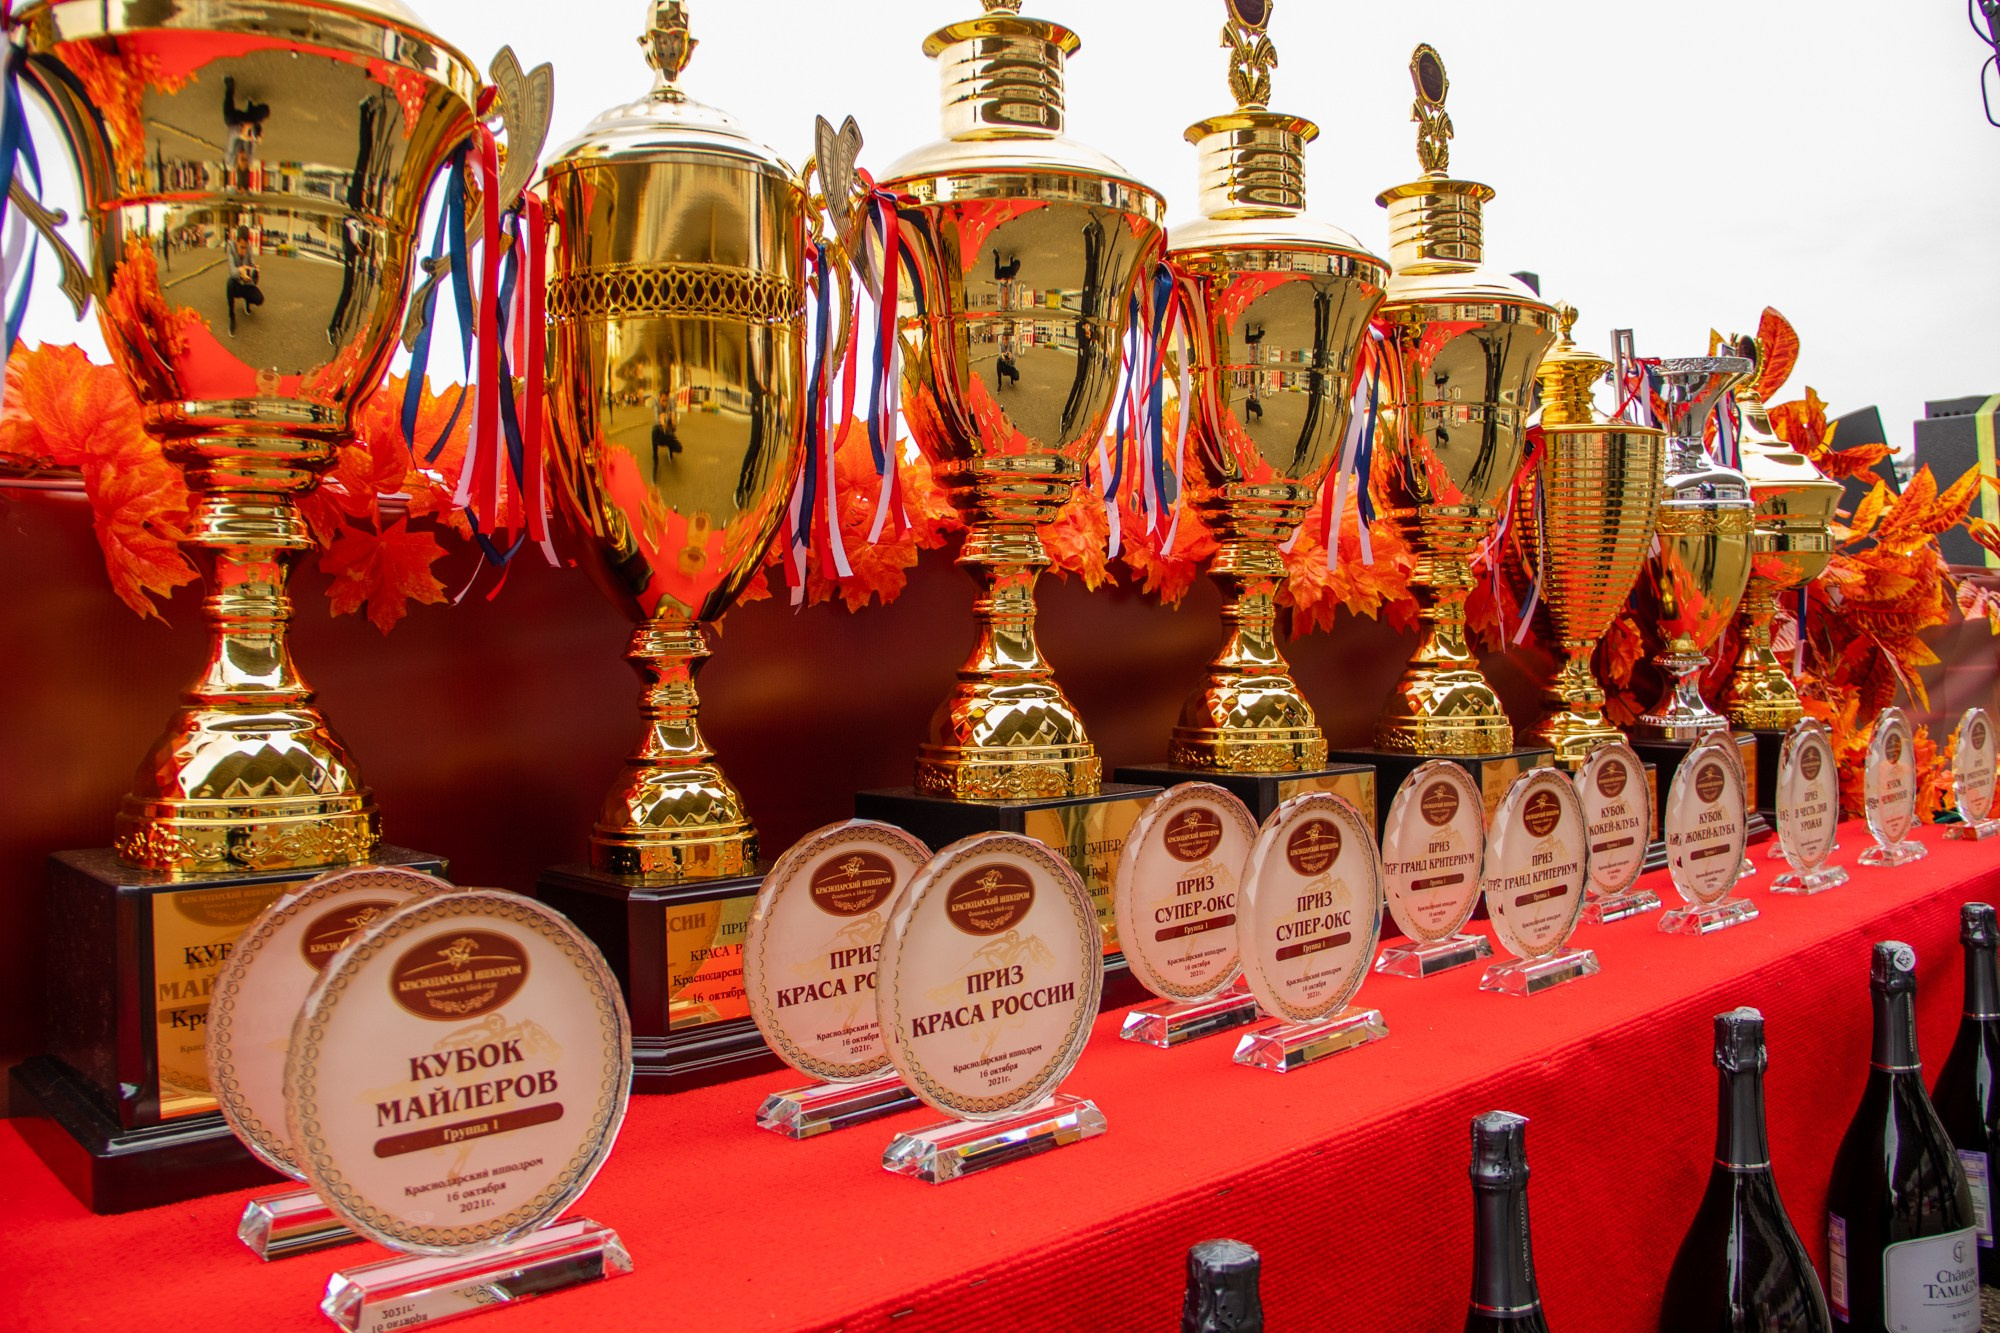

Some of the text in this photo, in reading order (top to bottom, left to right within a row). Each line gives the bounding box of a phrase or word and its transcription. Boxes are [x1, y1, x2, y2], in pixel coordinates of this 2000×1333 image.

[1601, 804, 1625, 818] КУБОК
[1699, 810, 1722, 824] КУБОК
[1428, 841, 1450, 854] ПРИЗ
[1401, 859, 1427, 874] ГРАНД
[1429, 853, 1475, 870] КРИТЕРИУМ
[1532, 852, 1553, 867] ПРИЗ
[1176, 875, 1215, 897] ПРИЗ
[1505, 873, 1531, 890] ГРАНД
[1533, 862, 1578, 883] КРИТЕРИУМ
[1155, 893, 1235, 924] СУПЕР-ОКС
[1297, 890, 1333, 913] ПРИЗ
[1276, 910, 1351, 942] СУПЕР-ОКС
[690, 946, 730, 962] КРАСА
[830, 943, 881, 969] ПРИЗ
[966, 965, 1024, 994] ПРИЗ
[693, 992, 704, 1004] 16
[777, 978, 847, 1008] КРАСА
[912, 982, 1075, 1038] КРАСА РОССИИ
[816, 1022, 869, 1042] Краснодарский
[852, 1032, 879, 1044] октября
[850, 1044, 872, 1054] 2021г.
[953, 1044, 1042, 1073] Краснодарский ипподром
[408, 1038, 525, 1082] КУБОК
[980, 1062, 1018, 1079] 16 октября
[988, 1076, 1011, 1087] 2021г.
[376, 1069, 559, 1127] МАЙЛЕРОВ
[443, 1123, 489, 1142] Группа
[404, 1157, 543, 1197] Краснодарский ипподром
[446, 1181, 506, 1203] 16 октября
[459, 1199, 496, 1213] 2021г.
